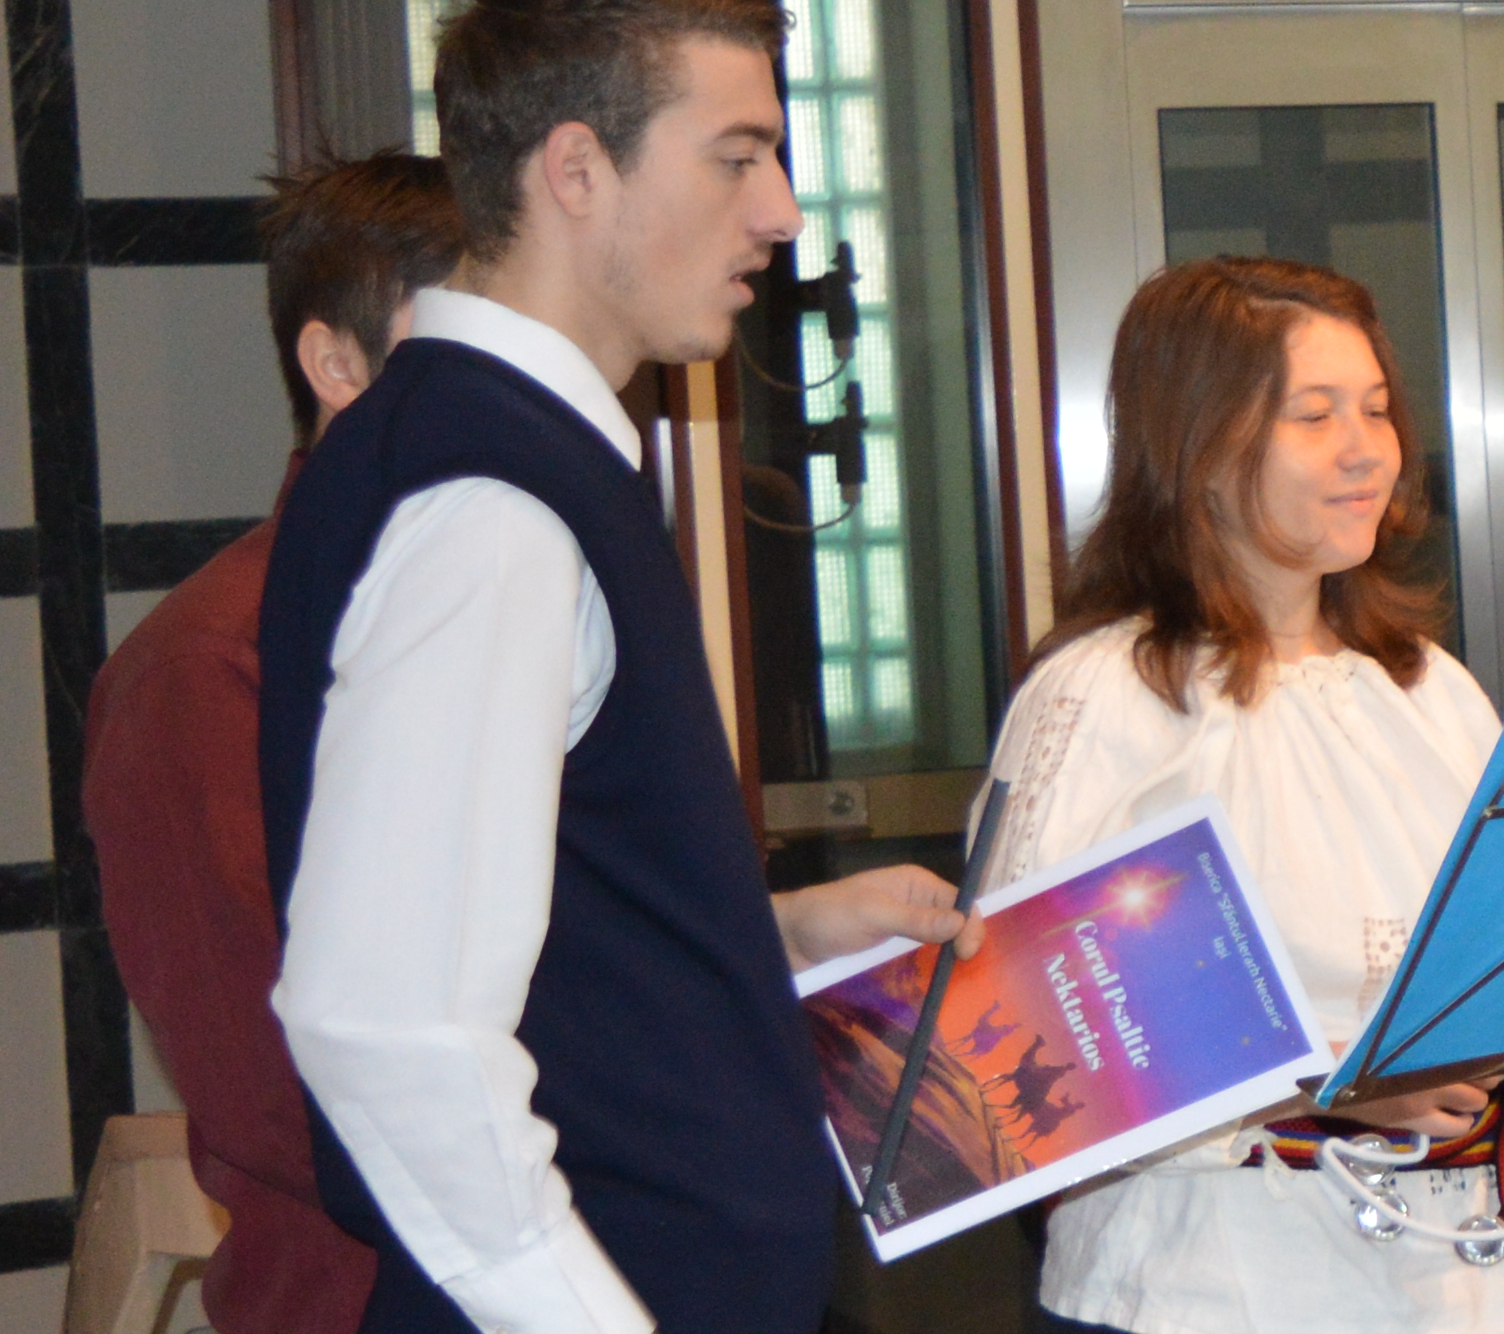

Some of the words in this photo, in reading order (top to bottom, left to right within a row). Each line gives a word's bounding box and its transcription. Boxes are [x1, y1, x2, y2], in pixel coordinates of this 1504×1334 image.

[1043, 953, 1105, 1073] Nektarios
[1075, 920, 1121, 988] Corul
[1102, 986, 1151, 1069] Psaltic
